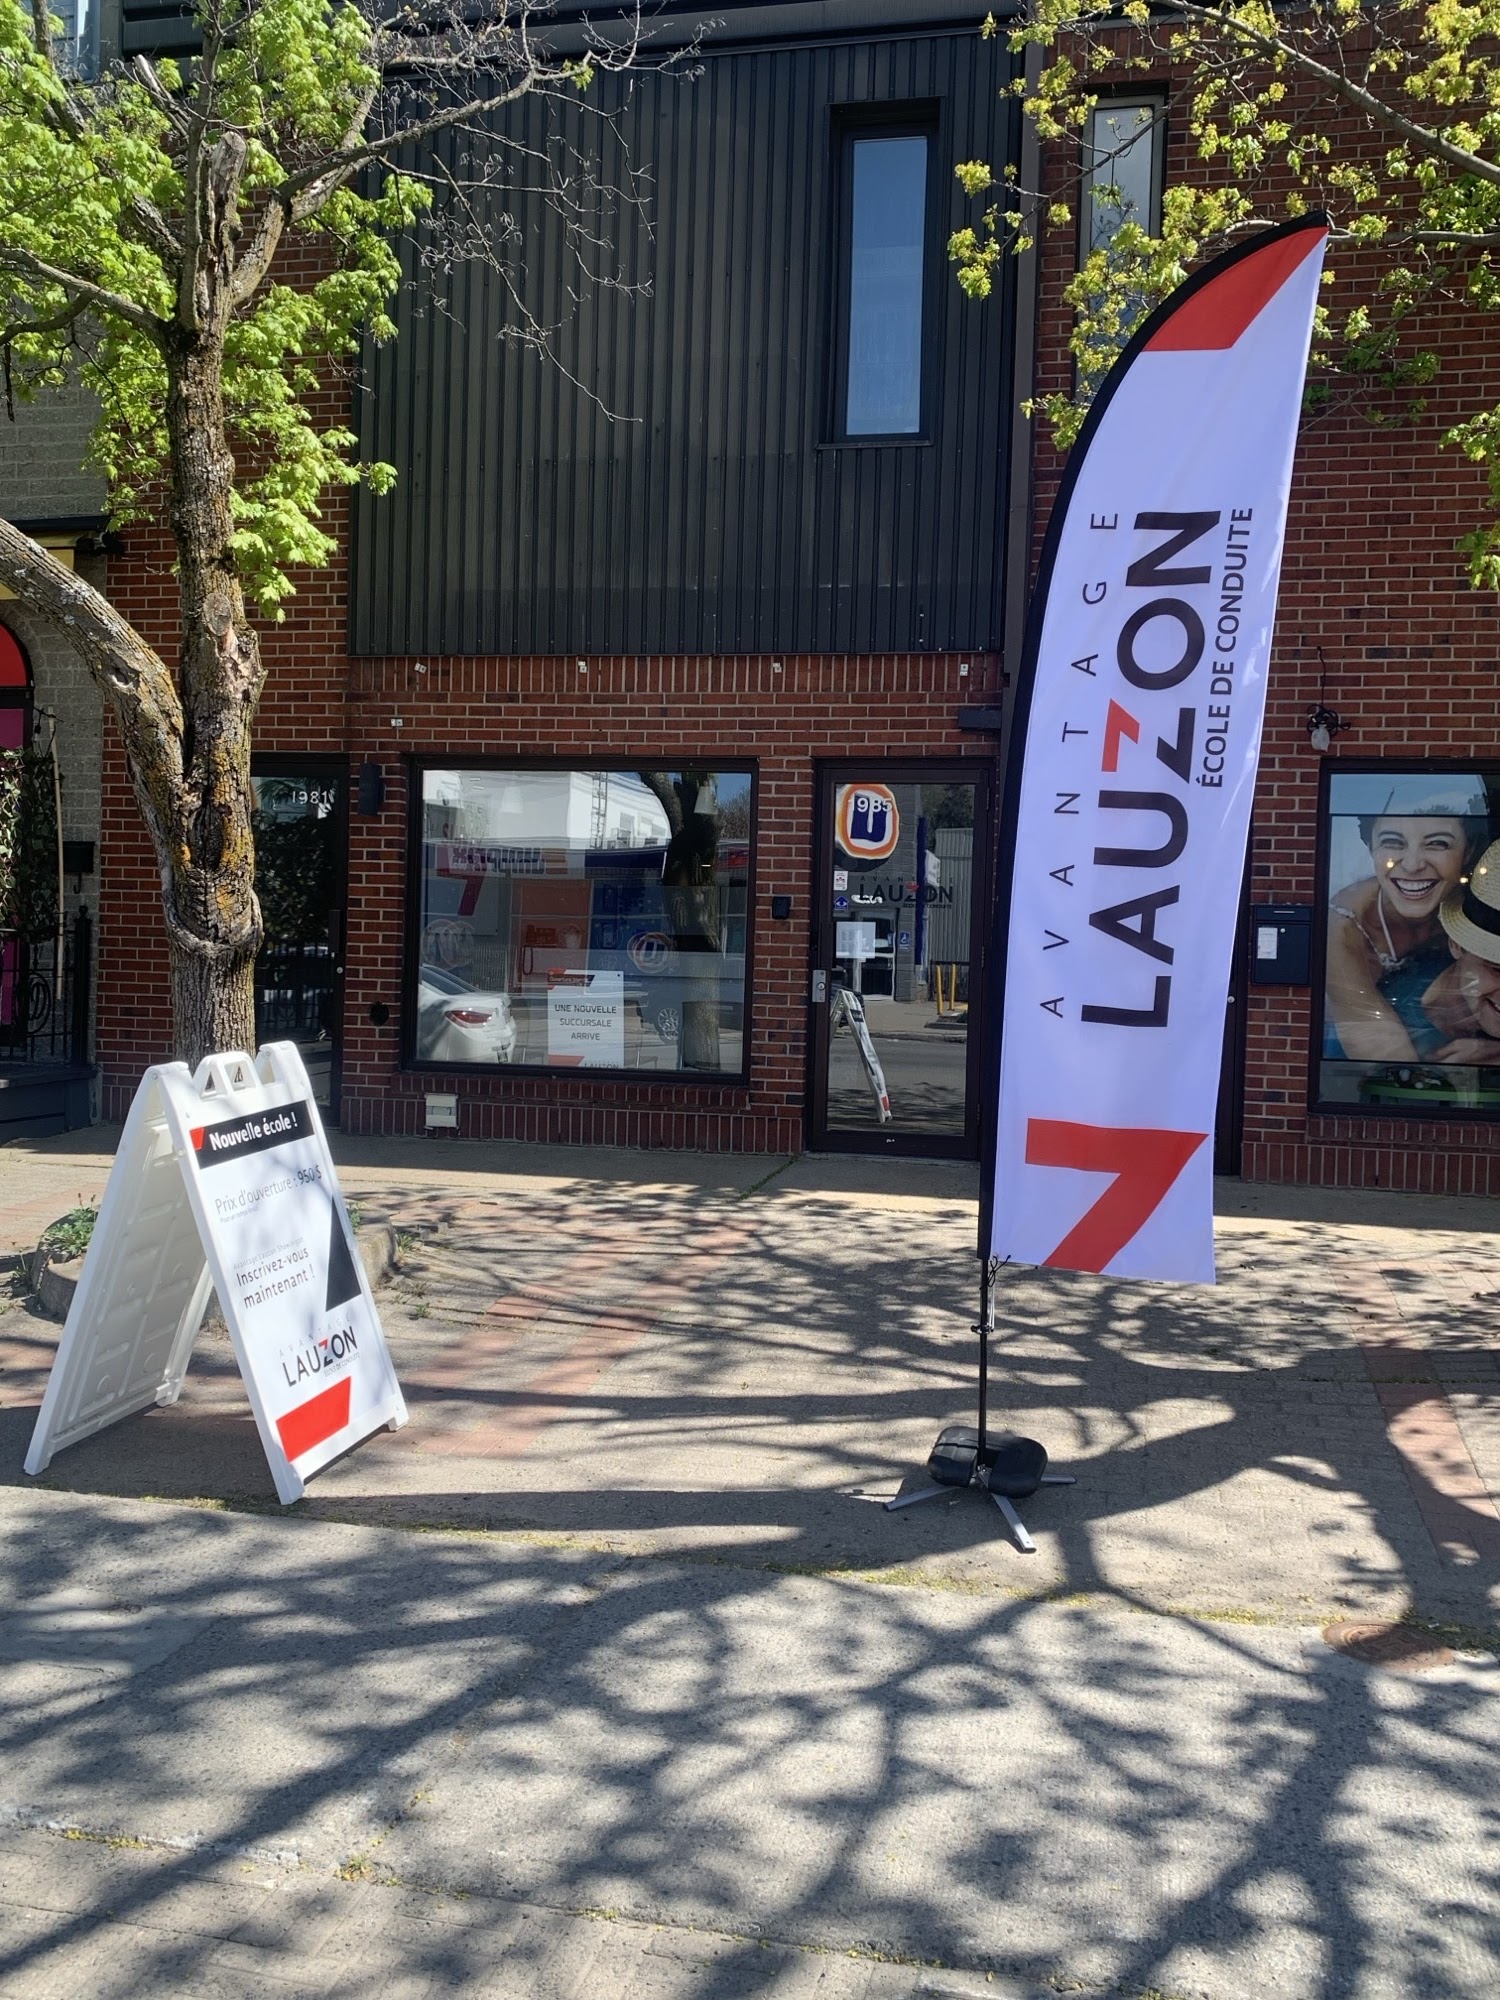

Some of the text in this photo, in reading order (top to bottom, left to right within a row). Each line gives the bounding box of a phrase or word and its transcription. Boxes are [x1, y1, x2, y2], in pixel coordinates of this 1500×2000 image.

[1195, 507, 1253, 788] ÉCOLE DE CONDUITE
[1039, 512, 1119, 1019] AVANTAGE
[1080, 509, 1222, 1028] LAUZON
[291, 790, 328, 804] 1981
[848, 798, 893, 813] 1985
[554, 1004, 617, 1014] UNE NOUVELLE
[559, 1018, 612, 1027] SUCCURSALE
[571, 1033, 601, 1041] ARRIVE
[209, 1121, 263, 1151] Nouvelle
[263, 1113, 291, 1137] école
[214, 1195, 238, 1215] Prix
[238, 1176, 293, 1207] d'ouverture
[297, 1168, 316, 1186] 950
[236, 1247, 309, 1286] Inscrivez-vous
[243, 1271, 309, 1309] maintenant
[282, 1325, 358, 1388] LAUZON
